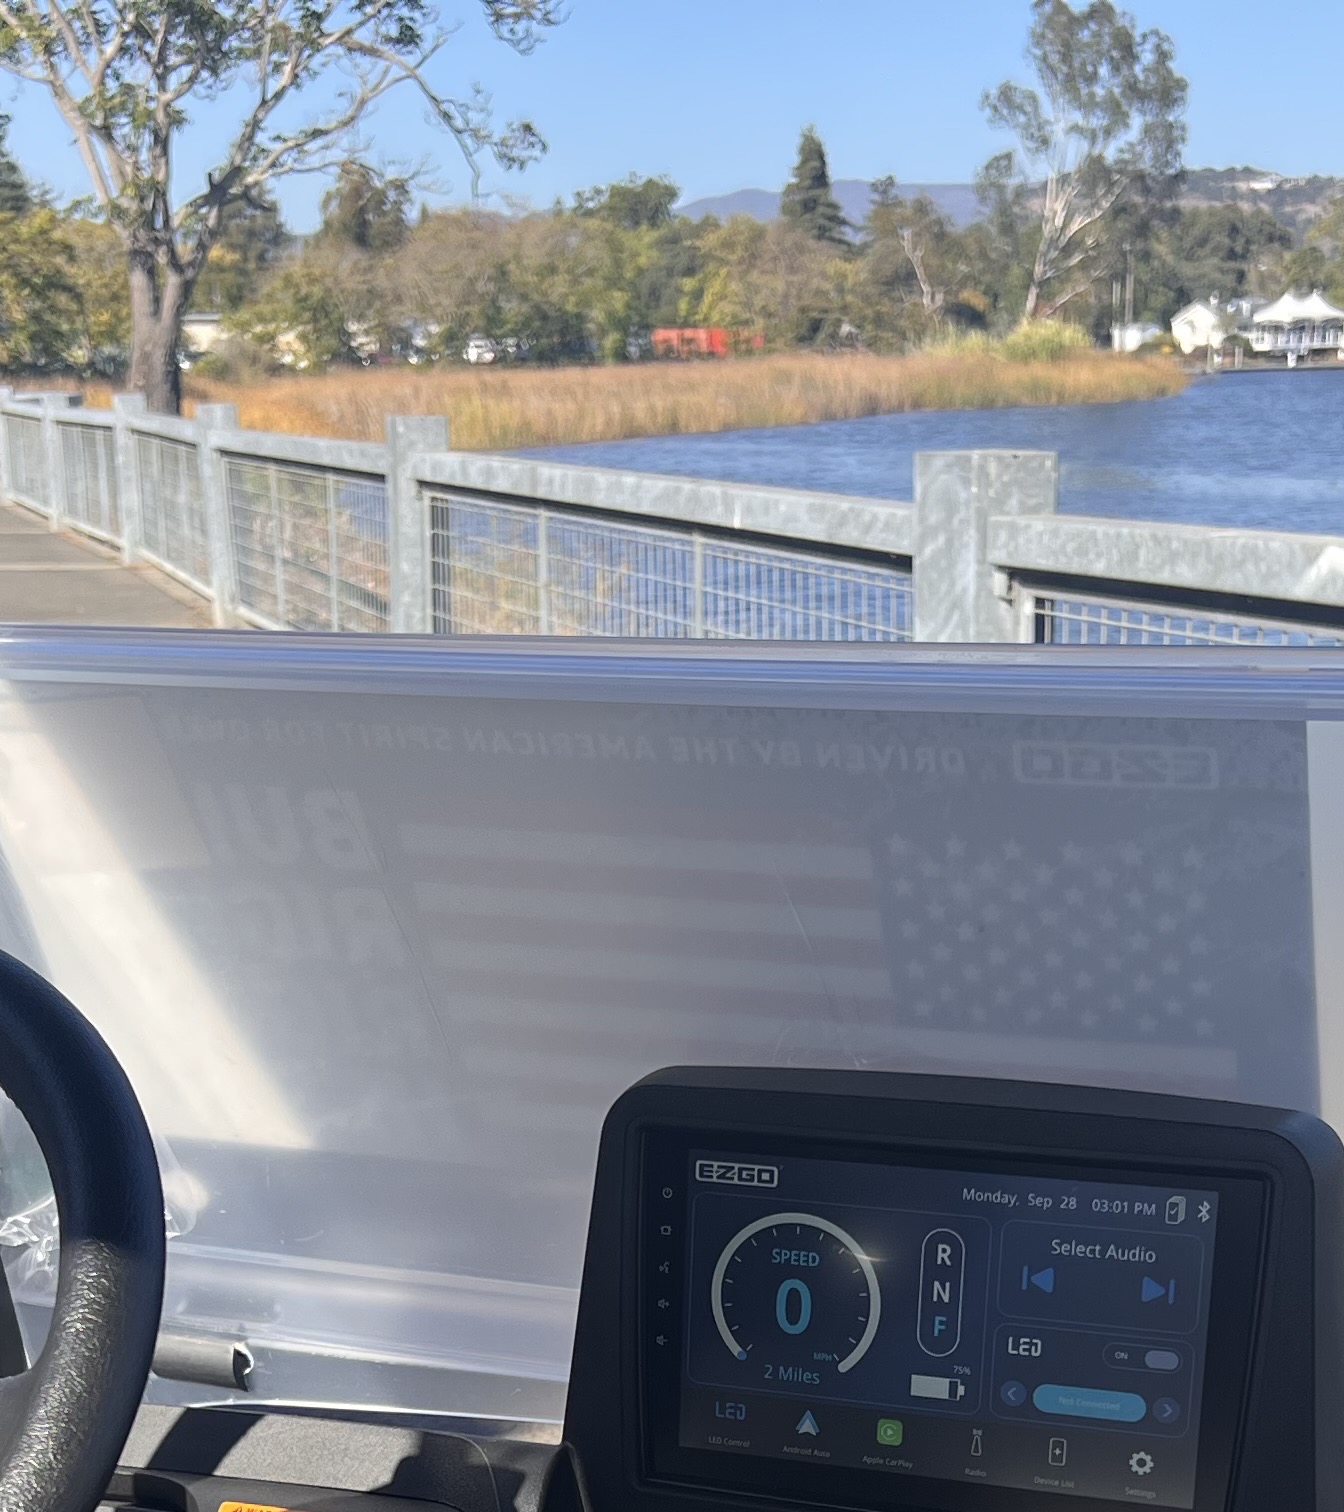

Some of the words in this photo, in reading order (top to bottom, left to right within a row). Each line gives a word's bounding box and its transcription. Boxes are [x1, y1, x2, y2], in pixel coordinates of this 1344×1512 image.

[696, 1161, 778, 1187] EZGO
[962, 1188, 1019, 1206] Monday,
[1027, 1193, 1052, 1210] Sep
[1060, 1196, 1077, 1210] 28
[1091, 1199, 1128, 1214] 03:01
[1134, 1202, 1156, 1216] PM
[772, 1249, 820, 1267] SPEED
[936, 1244, 952, 1266] R
[1051, 1239, 1101, 1258] Select
[1105, 1244, 1156, 1263] Audio
[933, 1281, 950, 1303] N
[776, 1278, 812, 1335] 0
[933, 1316, 947, 1337] F
[1007, 1336, 1042, 1357] LED
[813, 1352, 833, 1363] MPH
[763, 1364, 773, 1379] 2
[778, 1366, 821, 1385] Miles
[953, 1365, 971, 1376] 75%
[715, 1401, 746, 1420] LED
[782, 1445, 812, 1457] Android
[813, 1449, 831, 1459] Auto
[862, 1455, 884, 1467] Apple
[965, 1468, 987, 1478] Radio
[1033, 1475, 1060, 1488] Device
[1124, 1486, 1157, 1501] Settings
